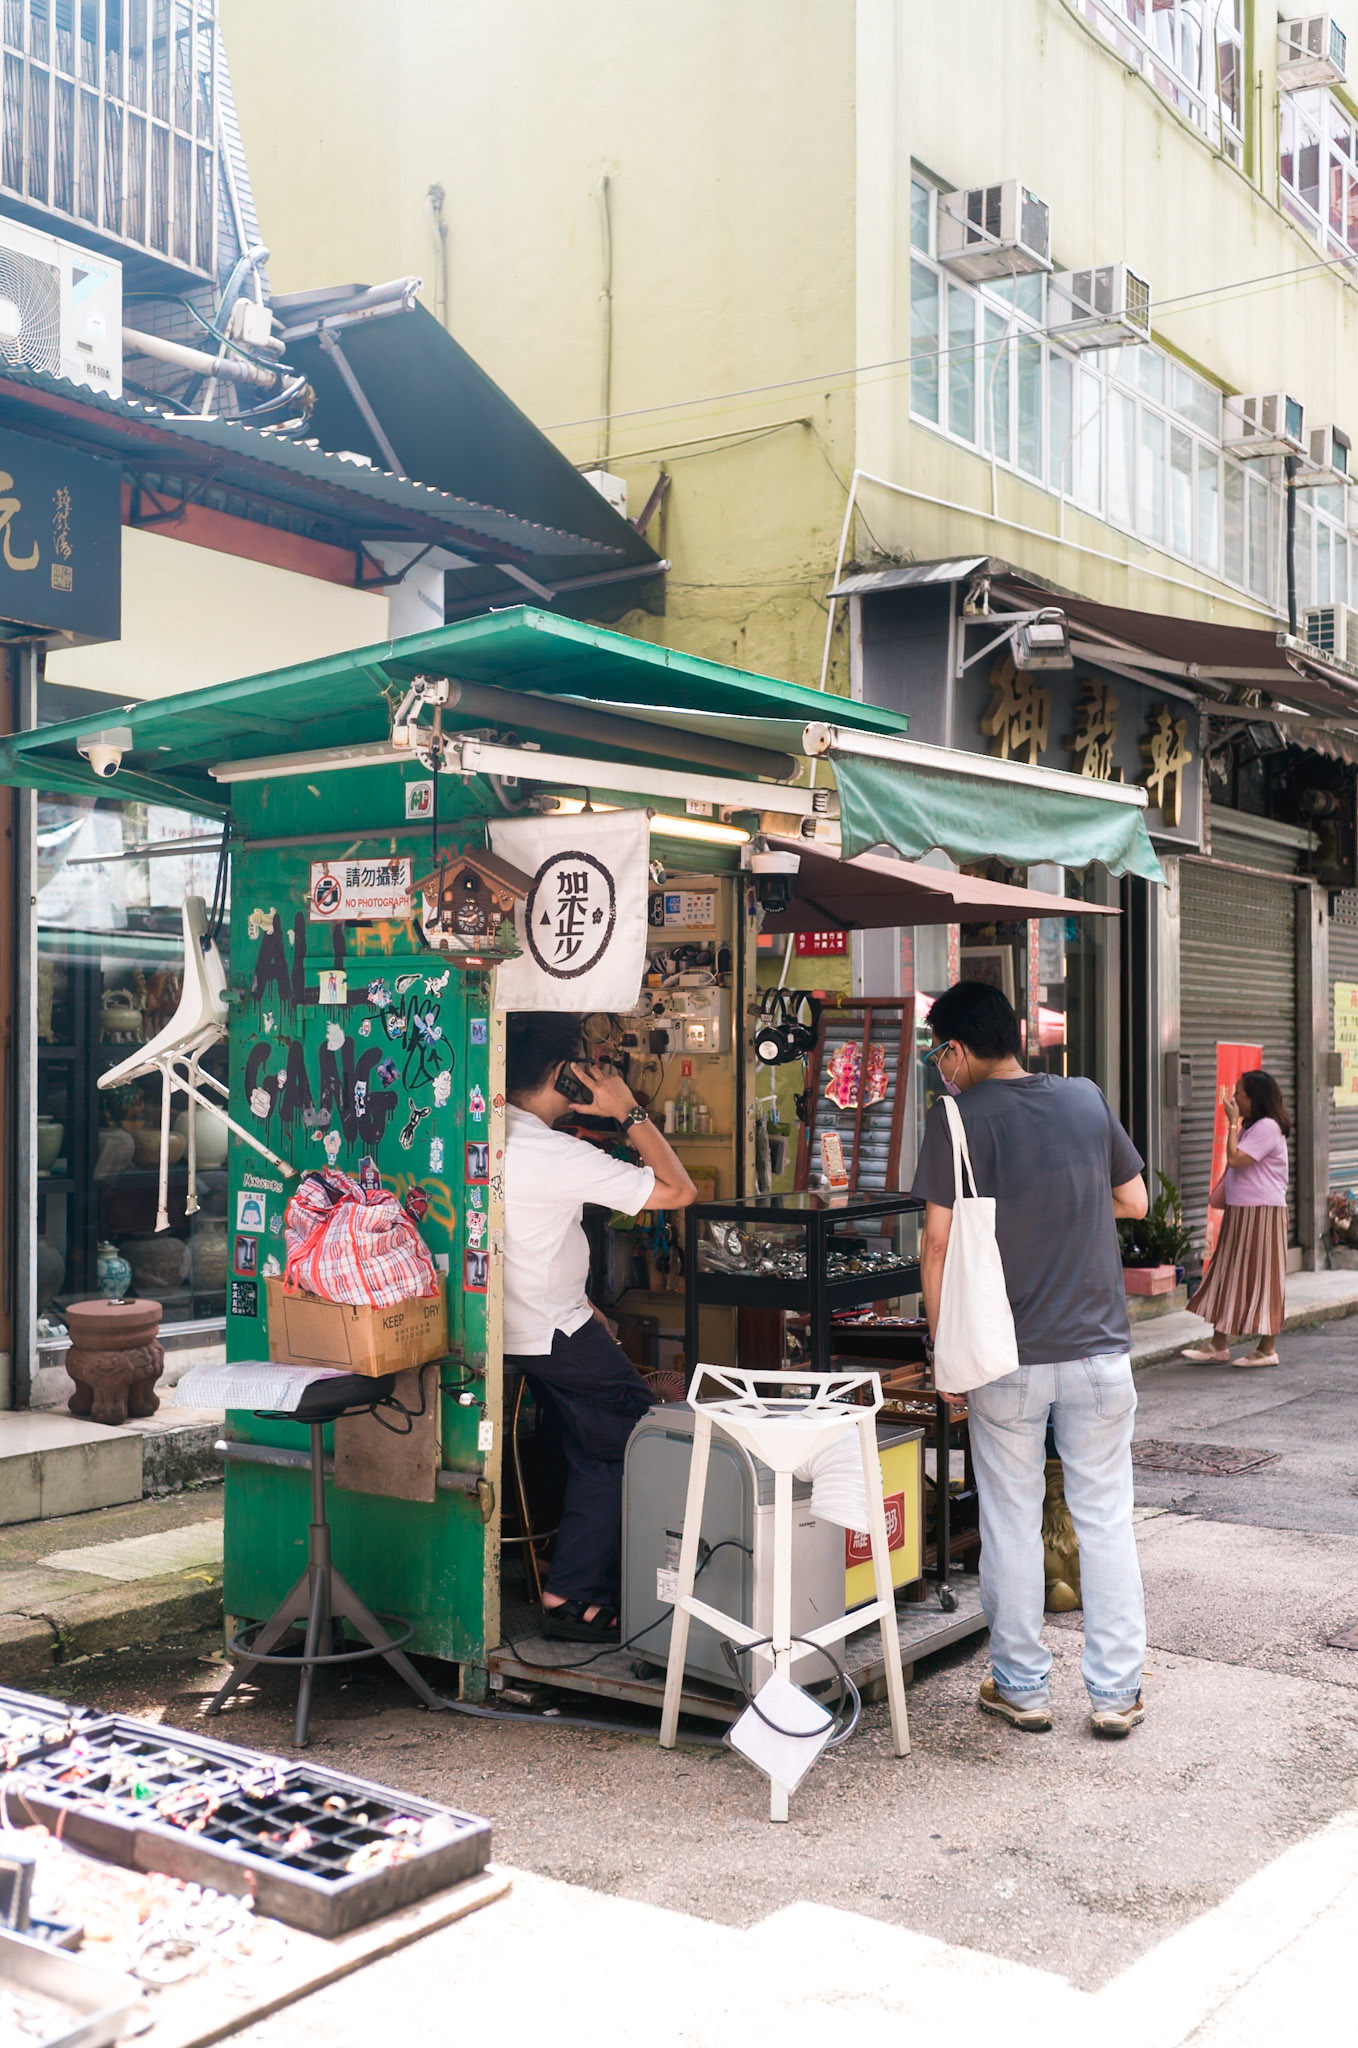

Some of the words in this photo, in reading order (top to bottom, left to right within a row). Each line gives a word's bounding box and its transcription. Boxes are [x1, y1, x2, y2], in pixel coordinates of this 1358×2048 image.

[72, 260, 110, 280] DAIKIN
[86, 363, 111, 381] R410A
[345, 866, 406, 888] 請勿攝影
[345, 898, 357, 908] NO
[357, 897, 410, 908] PHOTOGRAPH
[244, 1036, 399, 1143] GANG
[382, 1313, 405, 1330] KEEP
[424, 1303, 440, 1319] DRY
